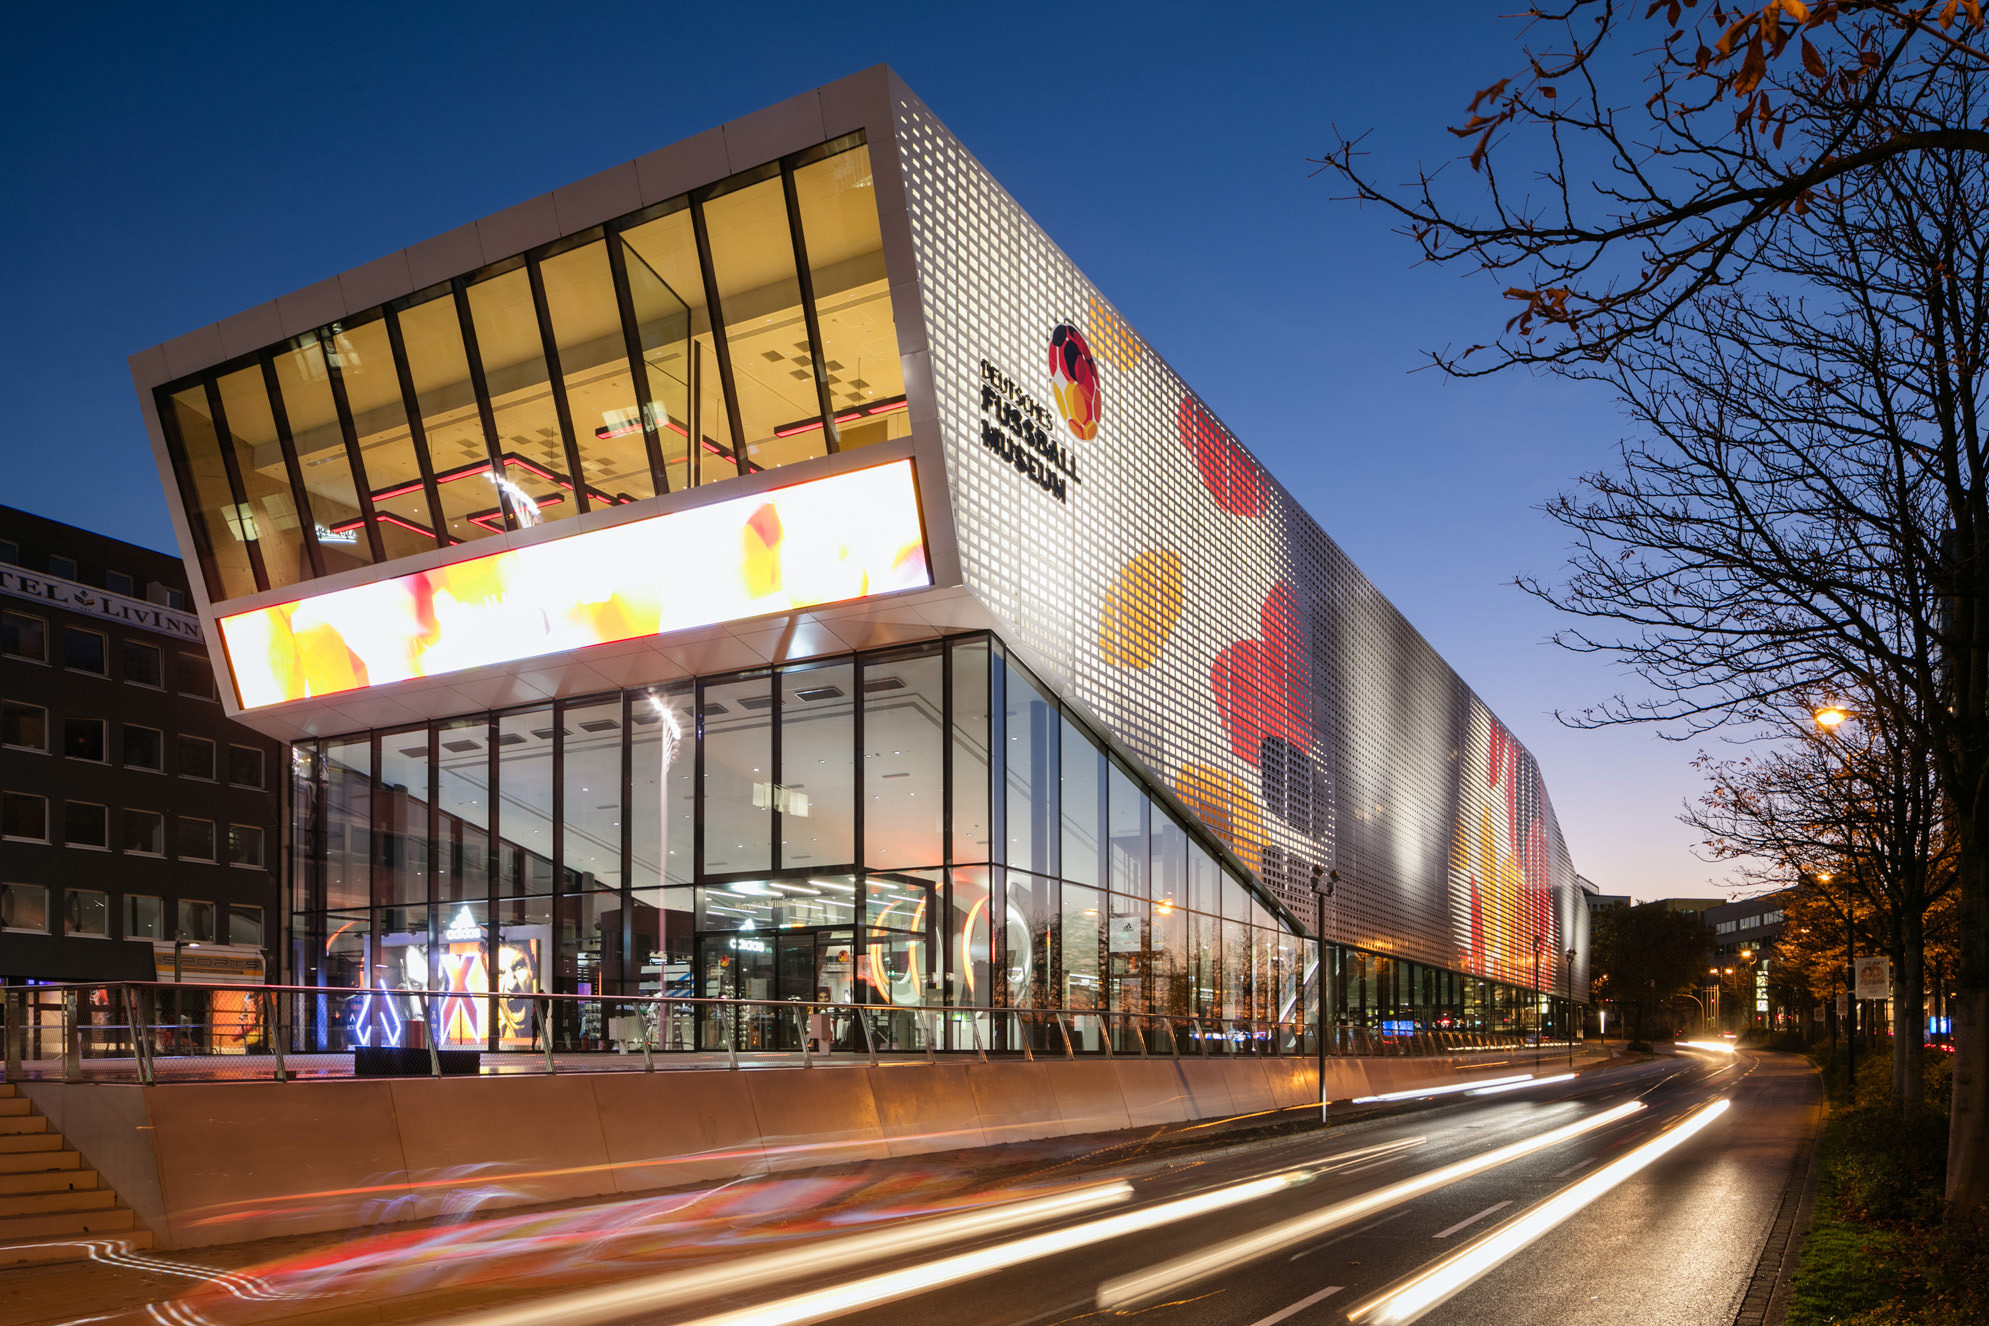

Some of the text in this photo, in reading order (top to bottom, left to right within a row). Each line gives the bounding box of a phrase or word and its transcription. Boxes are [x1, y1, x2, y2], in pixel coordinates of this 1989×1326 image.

[981, 358, 1053, 431] DEUTSCHES
[981, 383, 1082, 485] FUSSBALL
[981, 419, 1066, 505] MUSEUM
[160, 955, 259, 970] SPORTS
